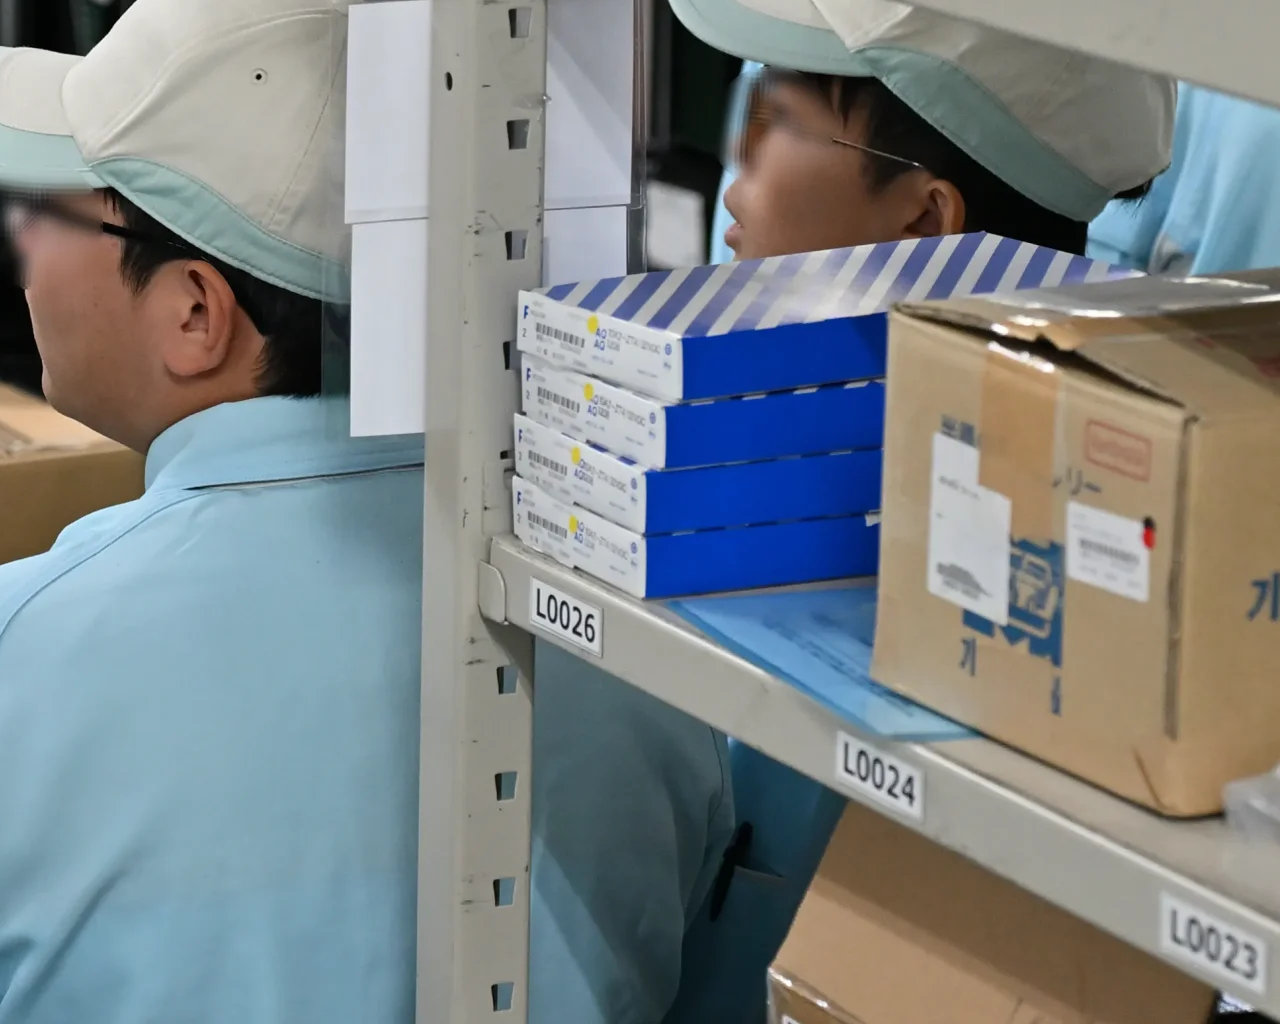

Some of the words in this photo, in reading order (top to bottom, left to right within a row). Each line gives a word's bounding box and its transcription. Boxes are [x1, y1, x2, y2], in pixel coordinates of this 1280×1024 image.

[536, 588, 595, 643] L0026
[844, 742, 915, 806] L0024
[1170, 909, 1257, 981] L0023
